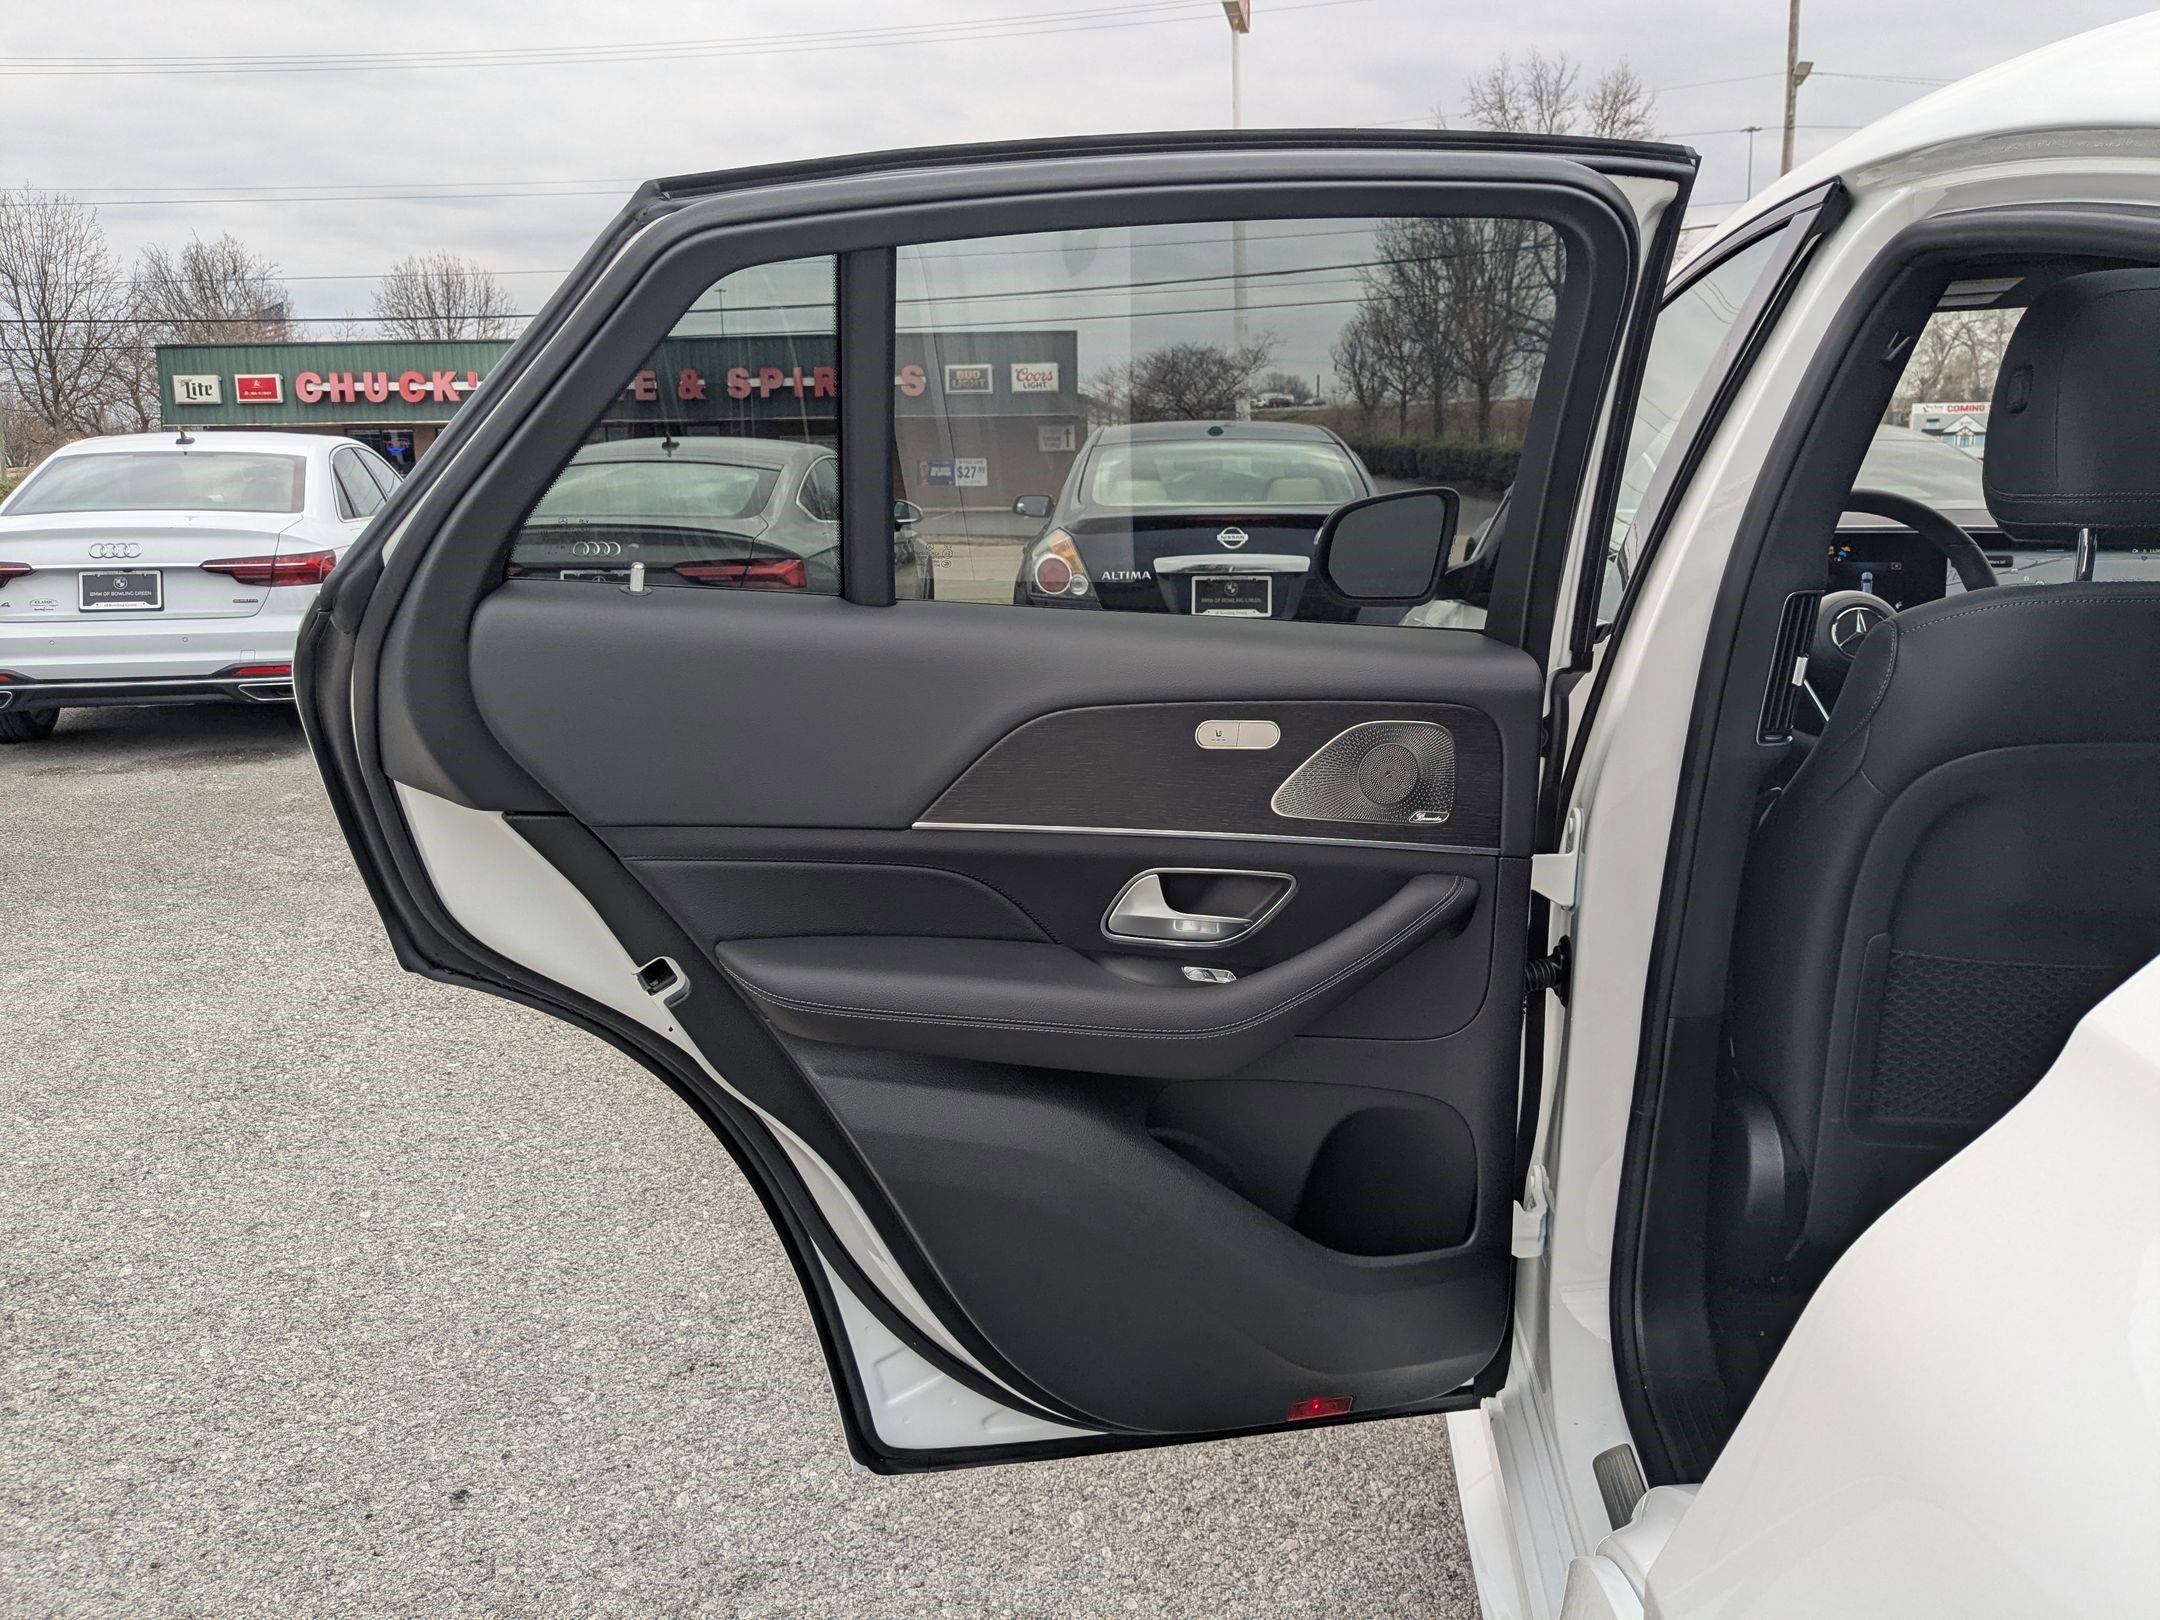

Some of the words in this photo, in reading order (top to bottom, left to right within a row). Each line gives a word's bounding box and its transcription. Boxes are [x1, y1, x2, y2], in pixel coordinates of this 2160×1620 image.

[956, 370, 981, 379] BUD
[1015, 368, 1053, 382] Coors
[295, 371, 478, 404] CHUCK'
[678, 368, 706, 400] &
[727, 364, 927, 399] SPIRS
[1023, 381, 1047, 389] LIGHT
[180, 382, 213, 400] Lite
[1101, 570, 1151, 581] ALTIMA
